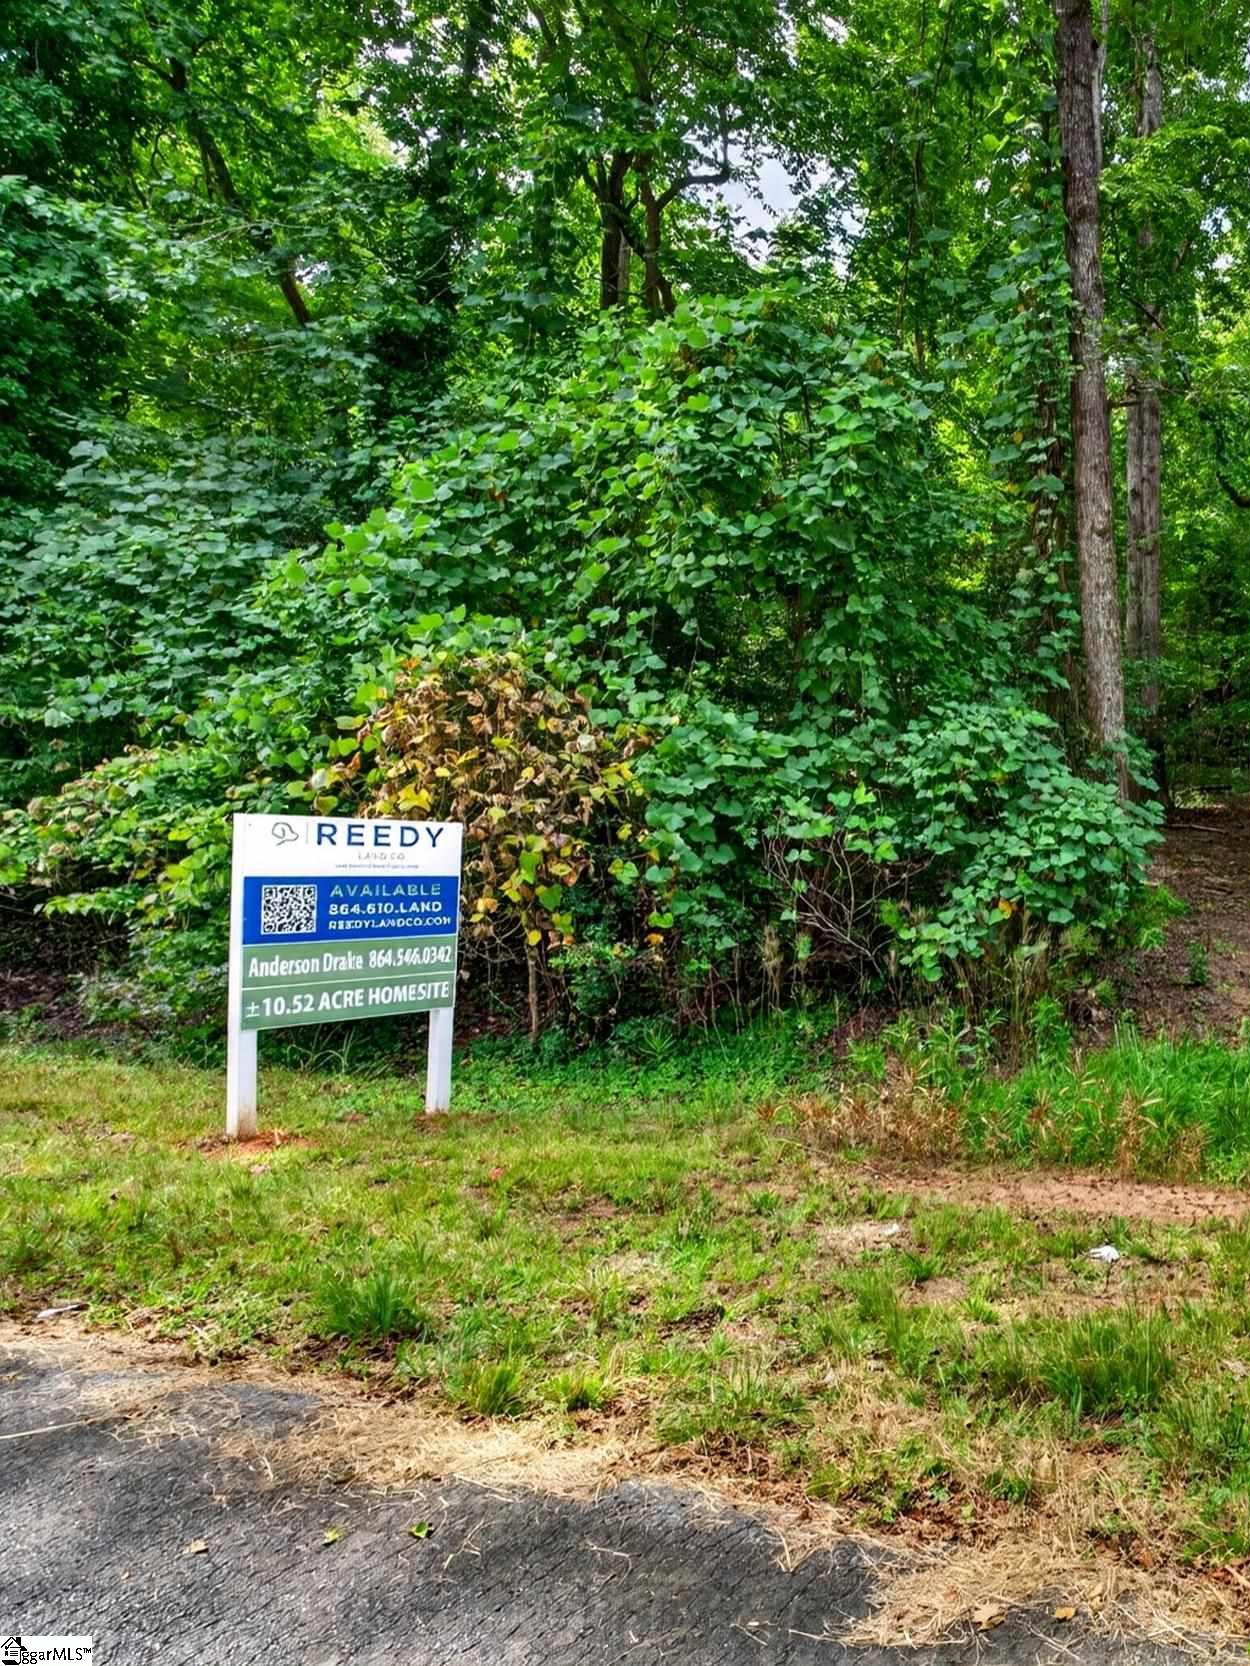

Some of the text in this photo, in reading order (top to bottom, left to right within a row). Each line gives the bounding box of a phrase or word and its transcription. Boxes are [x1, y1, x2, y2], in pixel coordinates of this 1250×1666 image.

[317, 822, 444, 848] REEDY
[330, 883, 441, 897] AVAILABLE
[328, 902, 442, 915] 864.610.LAND
[248, 945, 452, 978] Anderson Drake 864.546.0342
[318, 989, 364, 1011] ACRE
[368, 981, 449, 1005] HOMESITE
